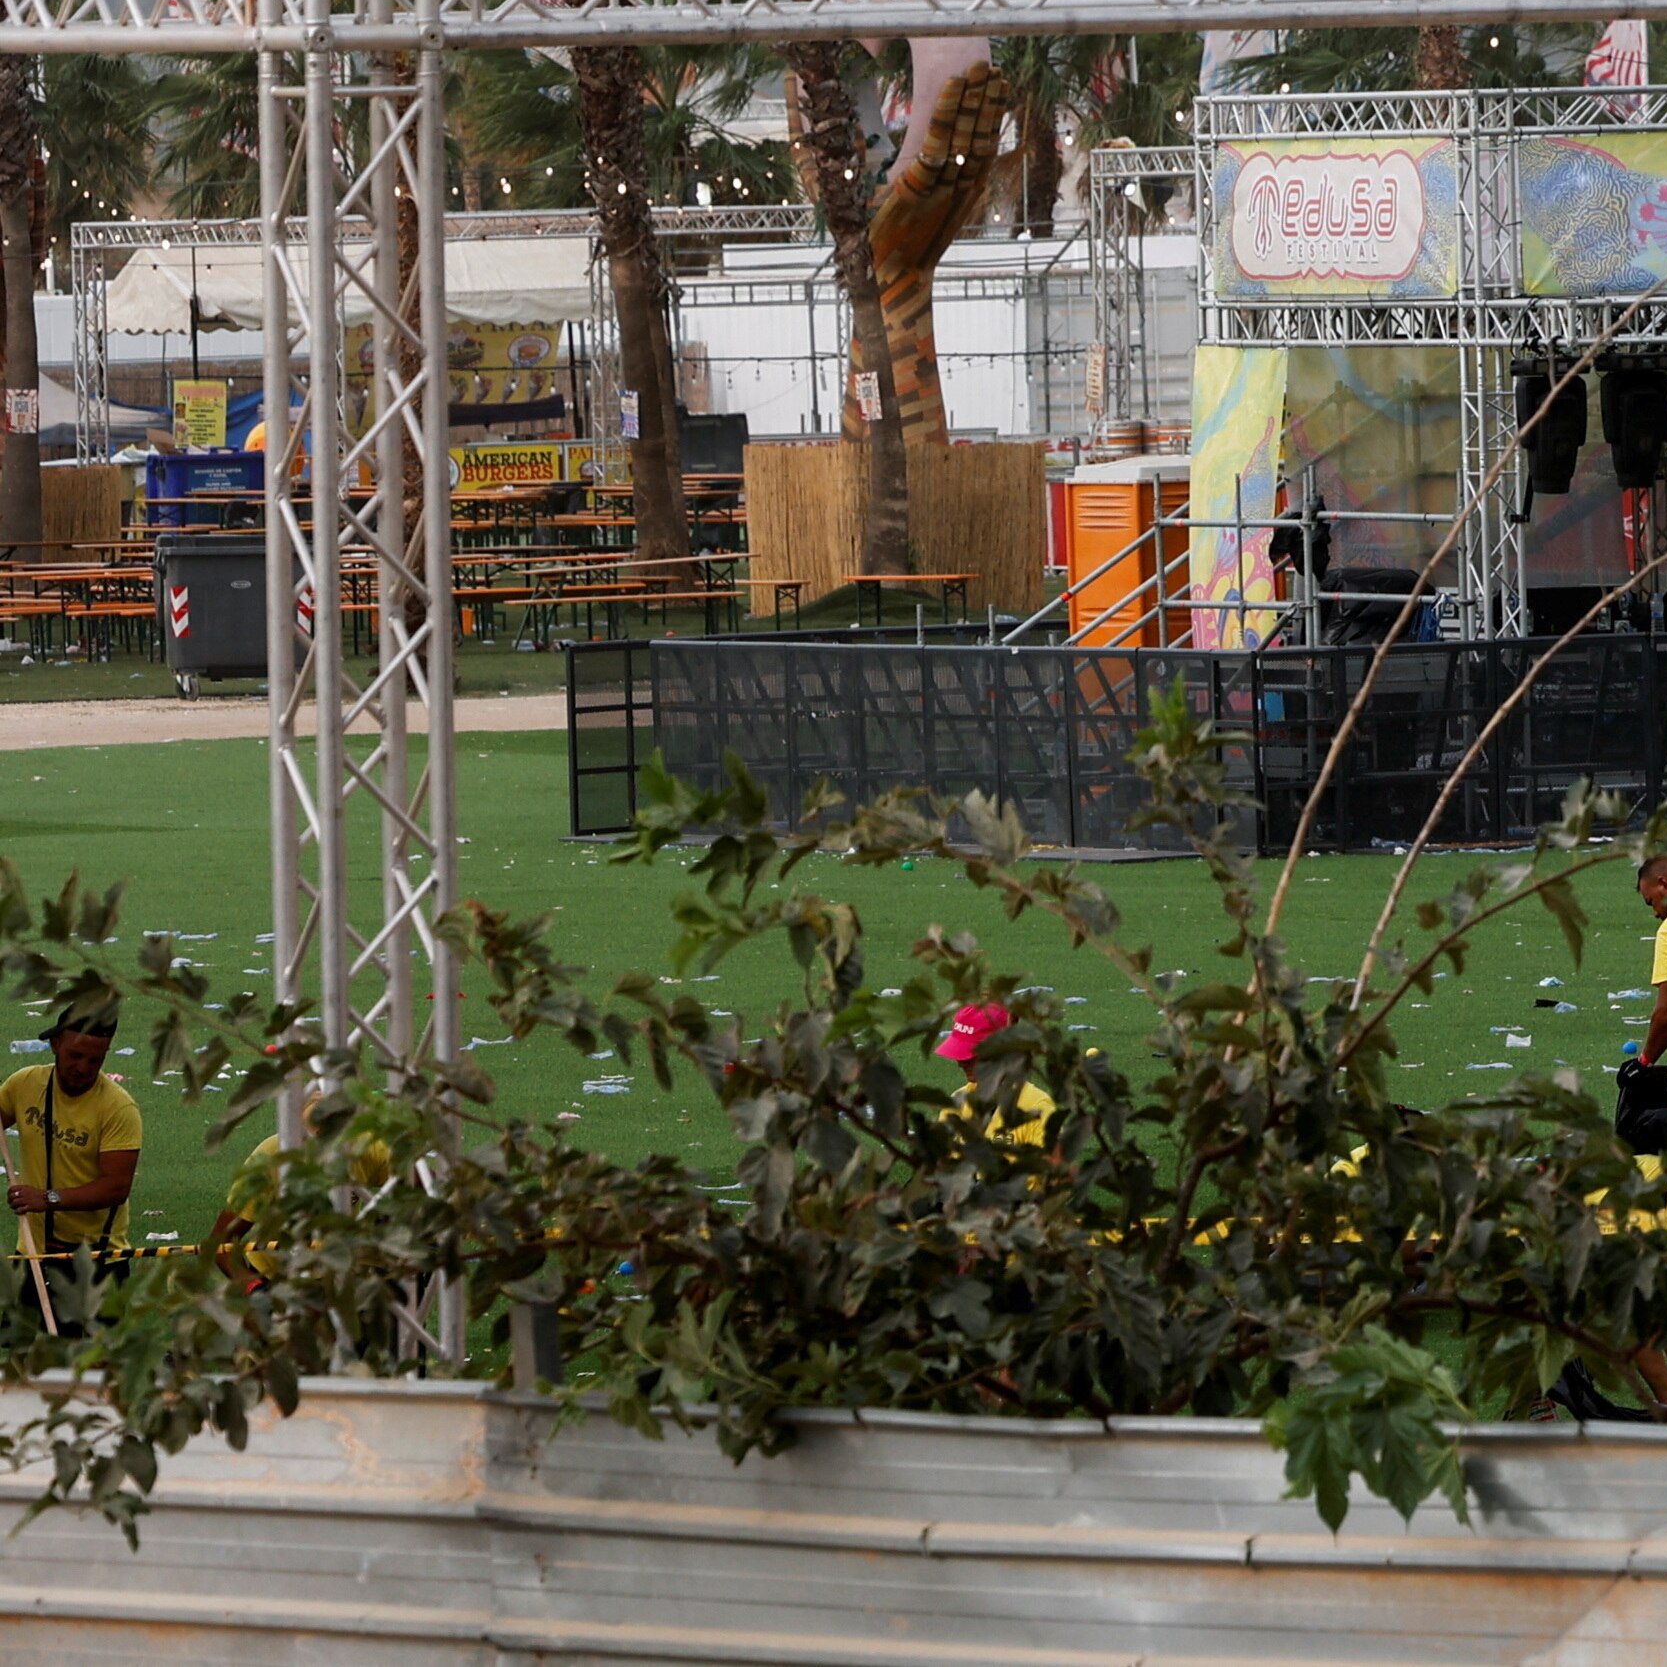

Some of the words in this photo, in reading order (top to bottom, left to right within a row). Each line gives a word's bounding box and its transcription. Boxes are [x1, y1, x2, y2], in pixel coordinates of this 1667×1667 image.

[1286, 243, 1377, 258] FESTIVAL
[462, 451, 553, 469] AMERICAN
[462, 465, 554, 483] BURGERS
